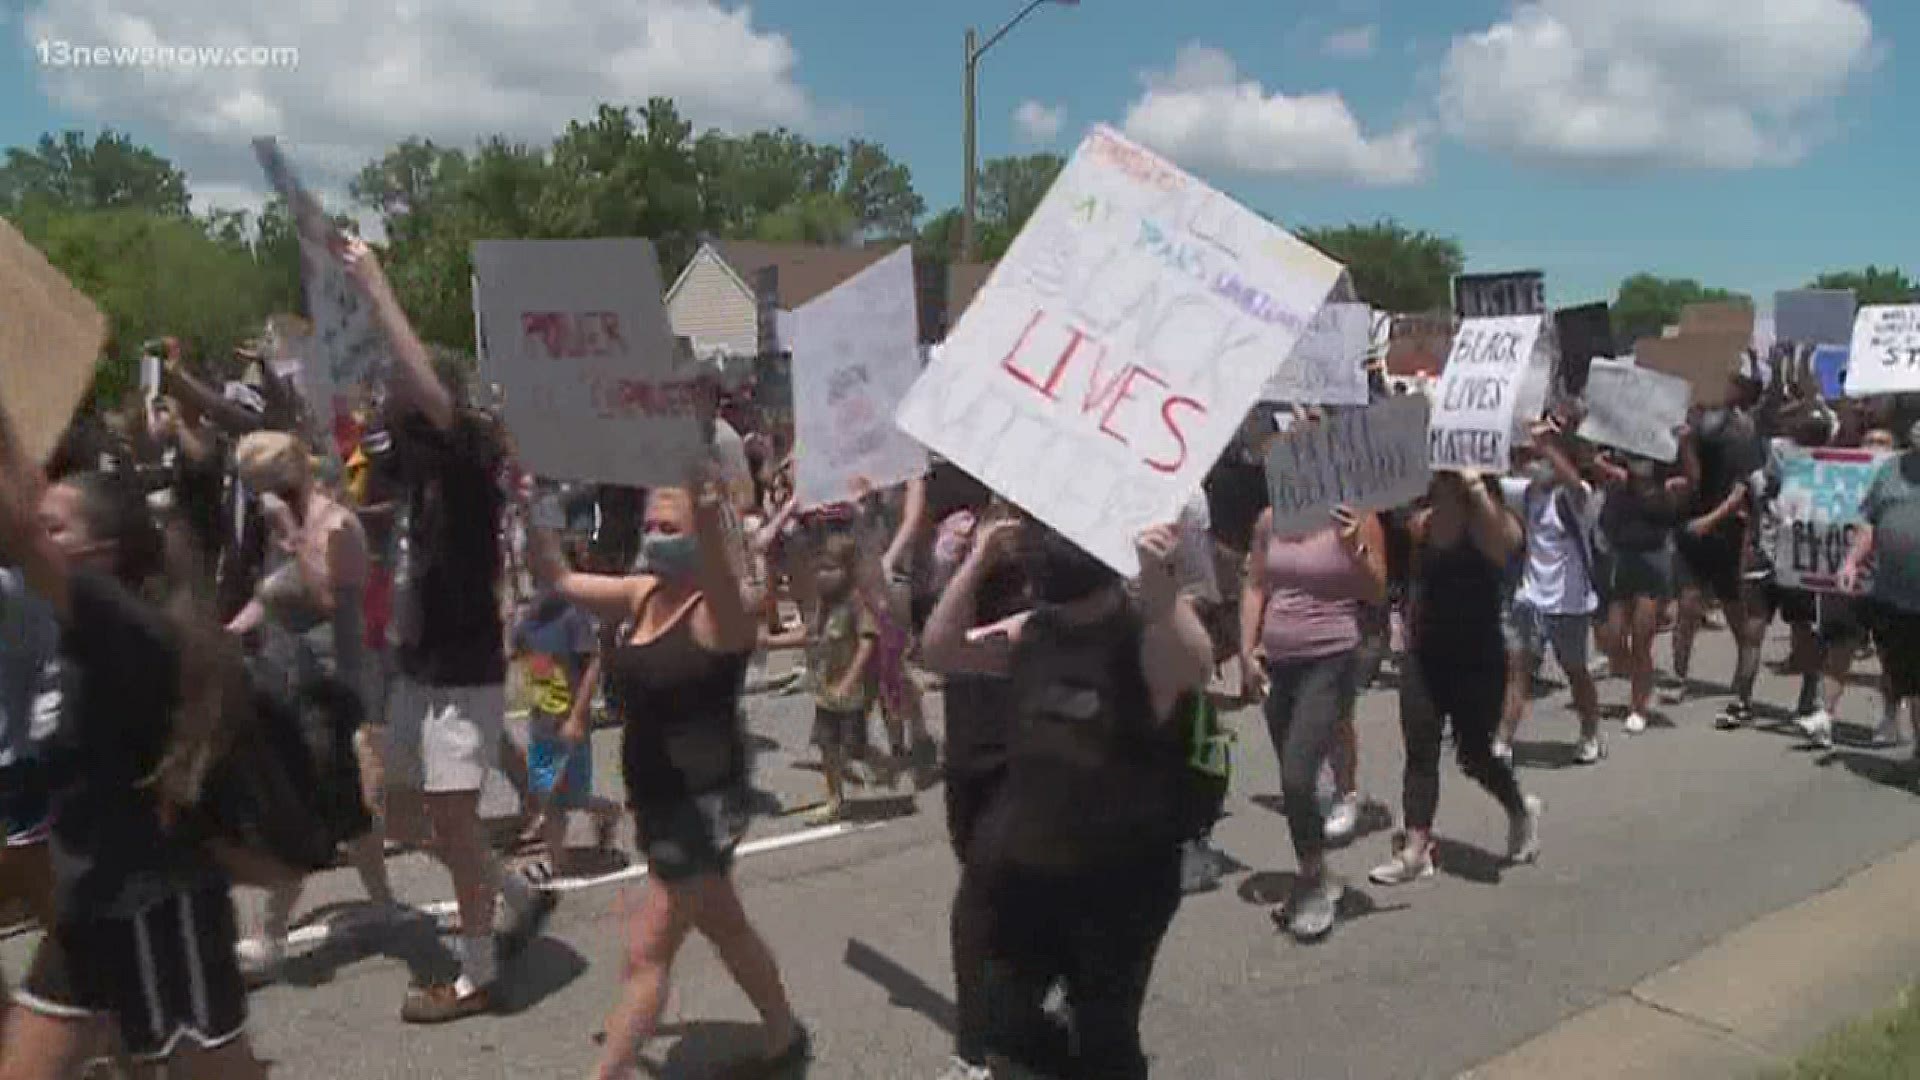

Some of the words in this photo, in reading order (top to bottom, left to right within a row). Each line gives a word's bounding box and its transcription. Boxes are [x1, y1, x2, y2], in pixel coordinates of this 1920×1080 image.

[1454, 329, 1522, 364] BLACK
[1000, 307, 1208, 476] LIVES
[1443, 374, 1509, 412] LIVES
[1431, 428, 1503, 463] MATTER
